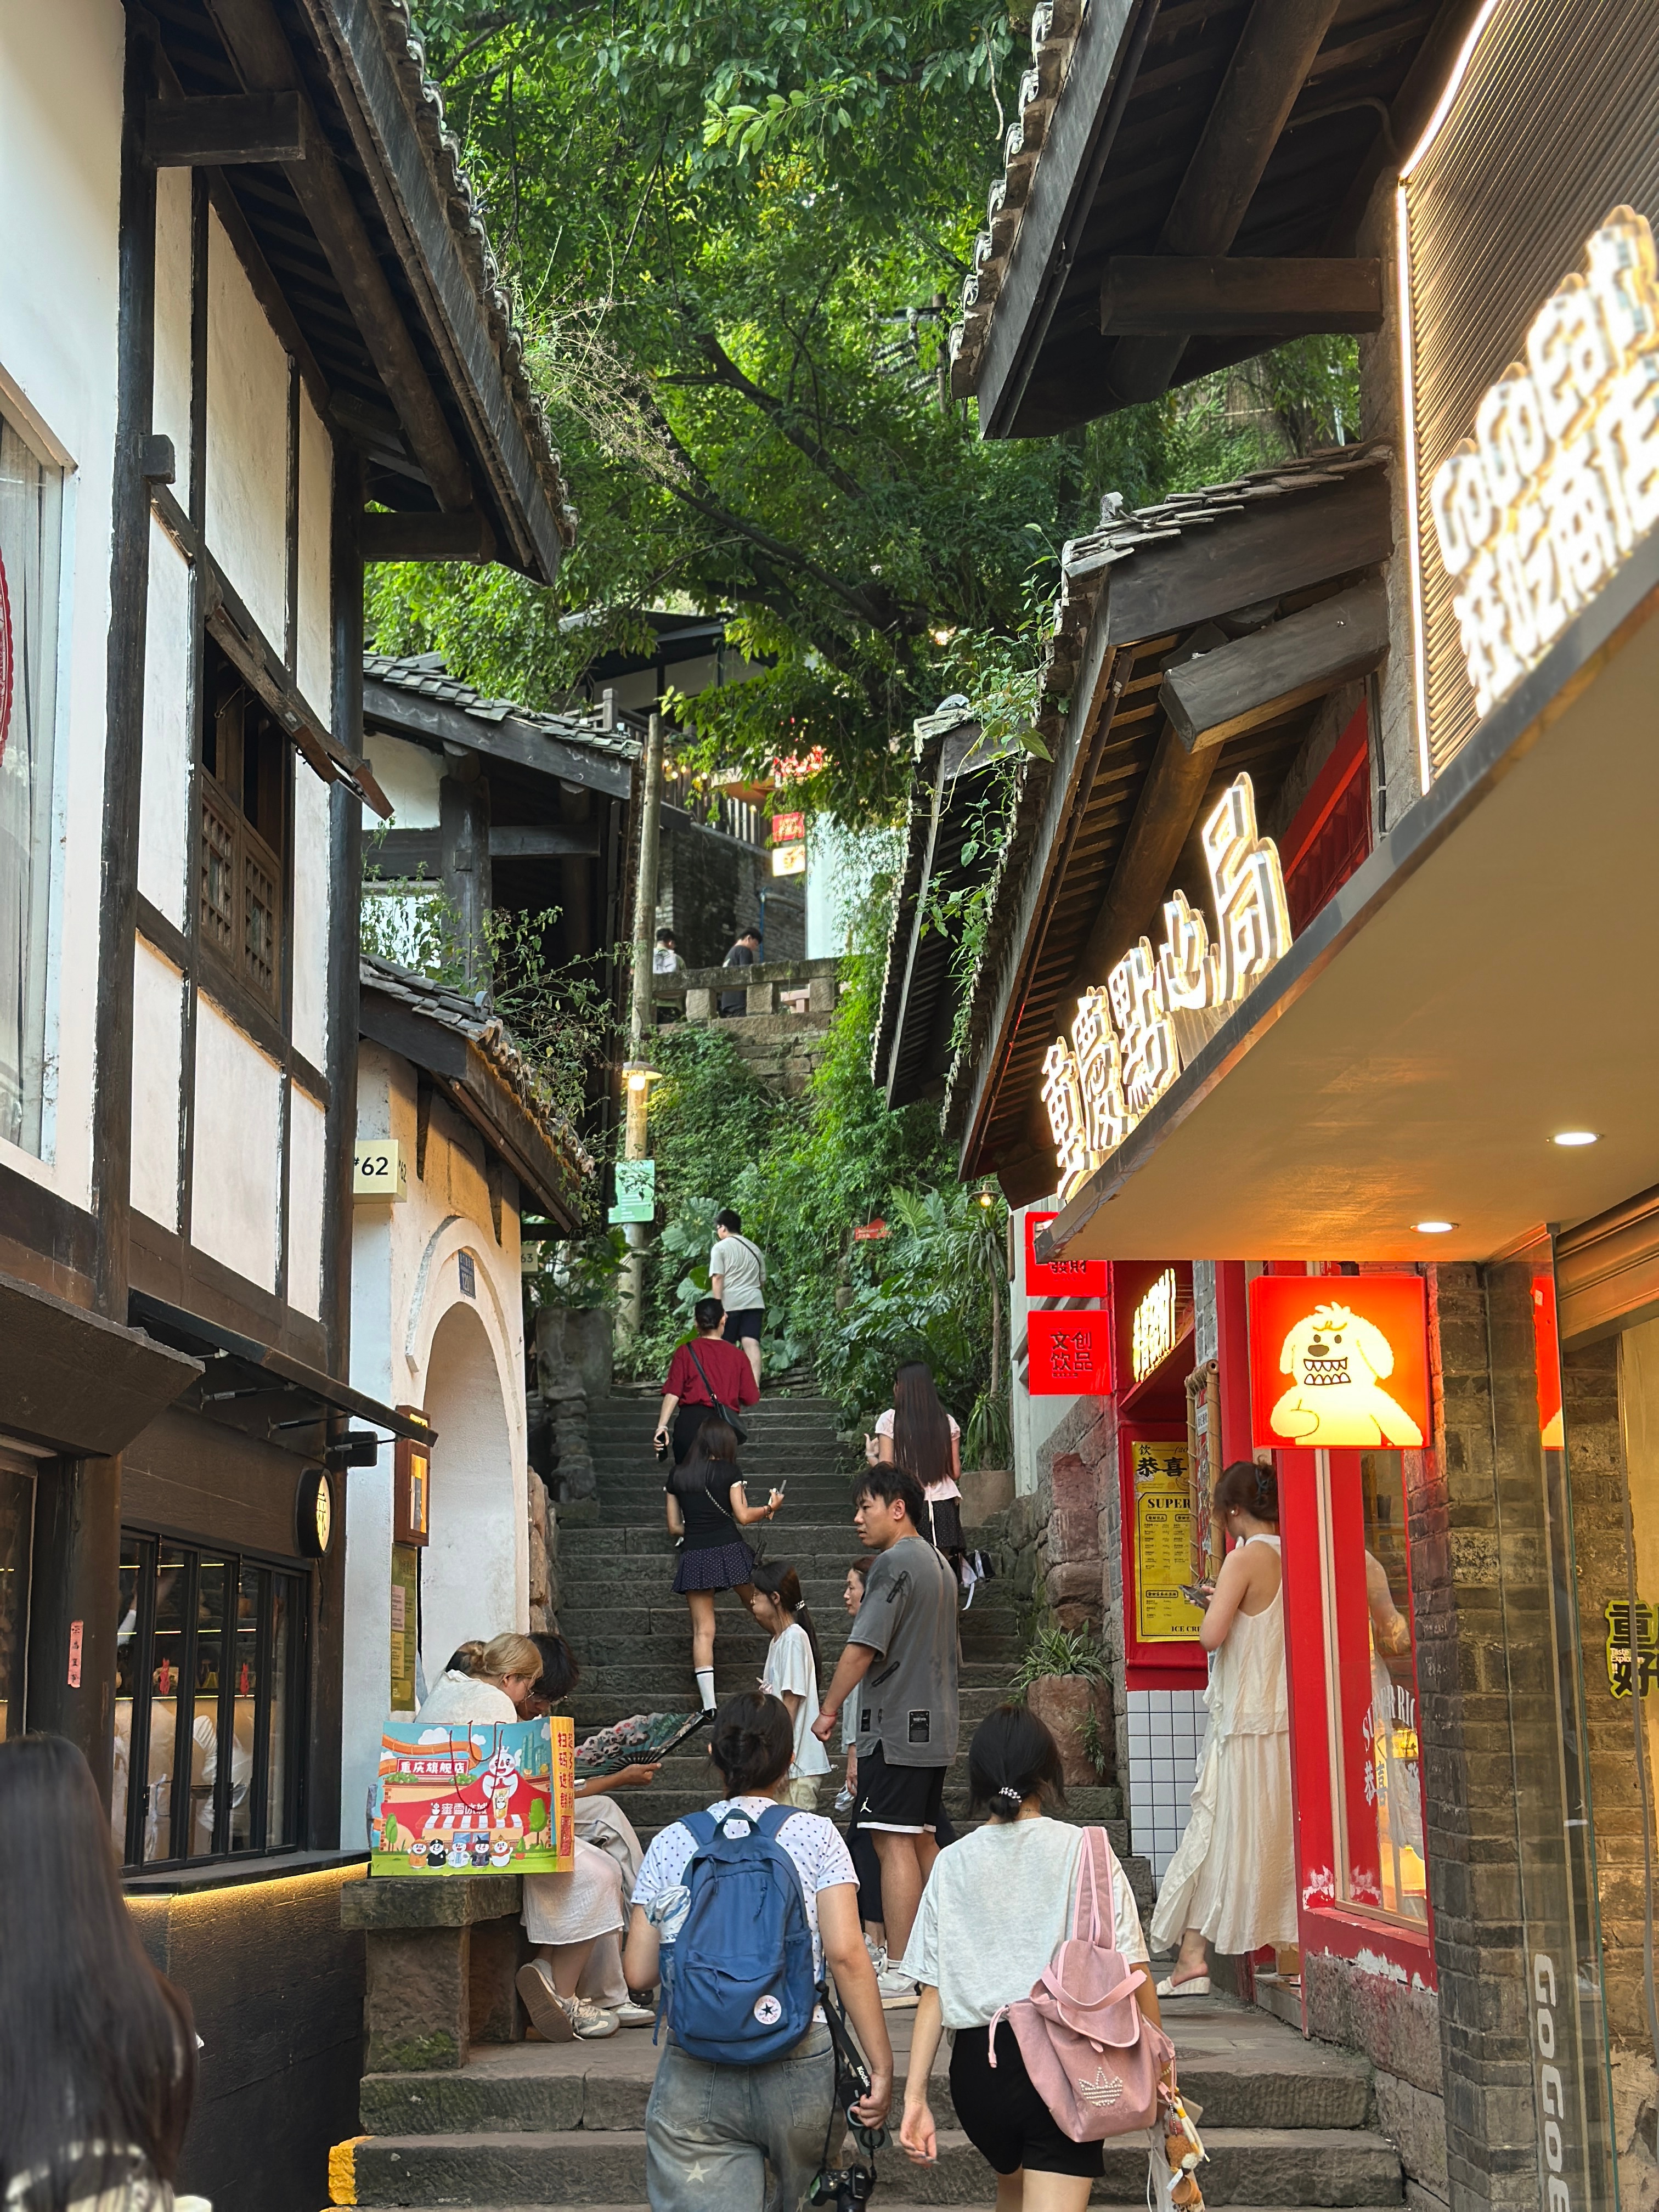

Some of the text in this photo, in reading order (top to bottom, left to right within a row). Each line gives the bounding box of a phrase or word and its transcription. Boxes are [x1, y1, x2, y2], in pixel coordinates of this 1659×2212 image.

[1050, 1331, 1092, 1350] 文创
[1051, 1352, 1093, 1371] 饮品
[1136, 1457, 1187, 1477] 恭喜
[1609, 1604, 1659, 1650] 重
[1613, 1651, 1659, 1697] 好
[400, 1761, 465, 1774] 重庆旗舰店
[856, 2066, 871, 2088] Kodak
